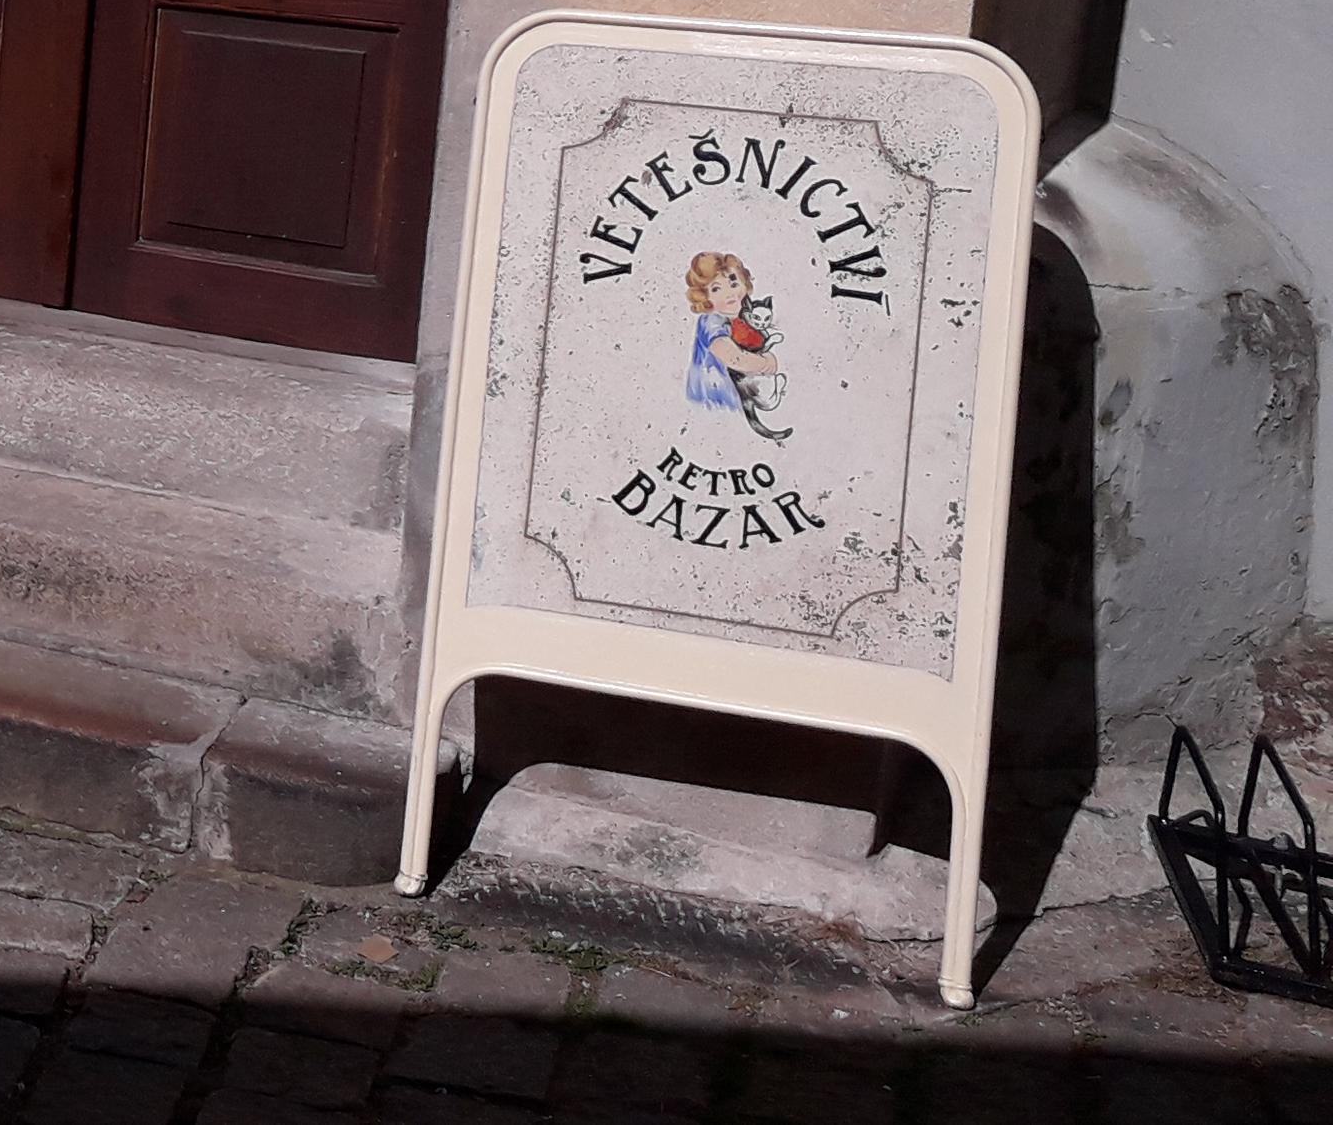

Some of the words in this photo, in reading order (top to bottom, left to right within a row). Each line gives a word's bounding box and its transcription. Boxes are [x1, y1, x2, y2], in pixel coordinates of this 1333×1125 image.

[581, 129, 891, 316] VETEŠNICTVÍ
[612, 470, 825, 548] BAZAR
[657, 448, 776, 495] RETRO
